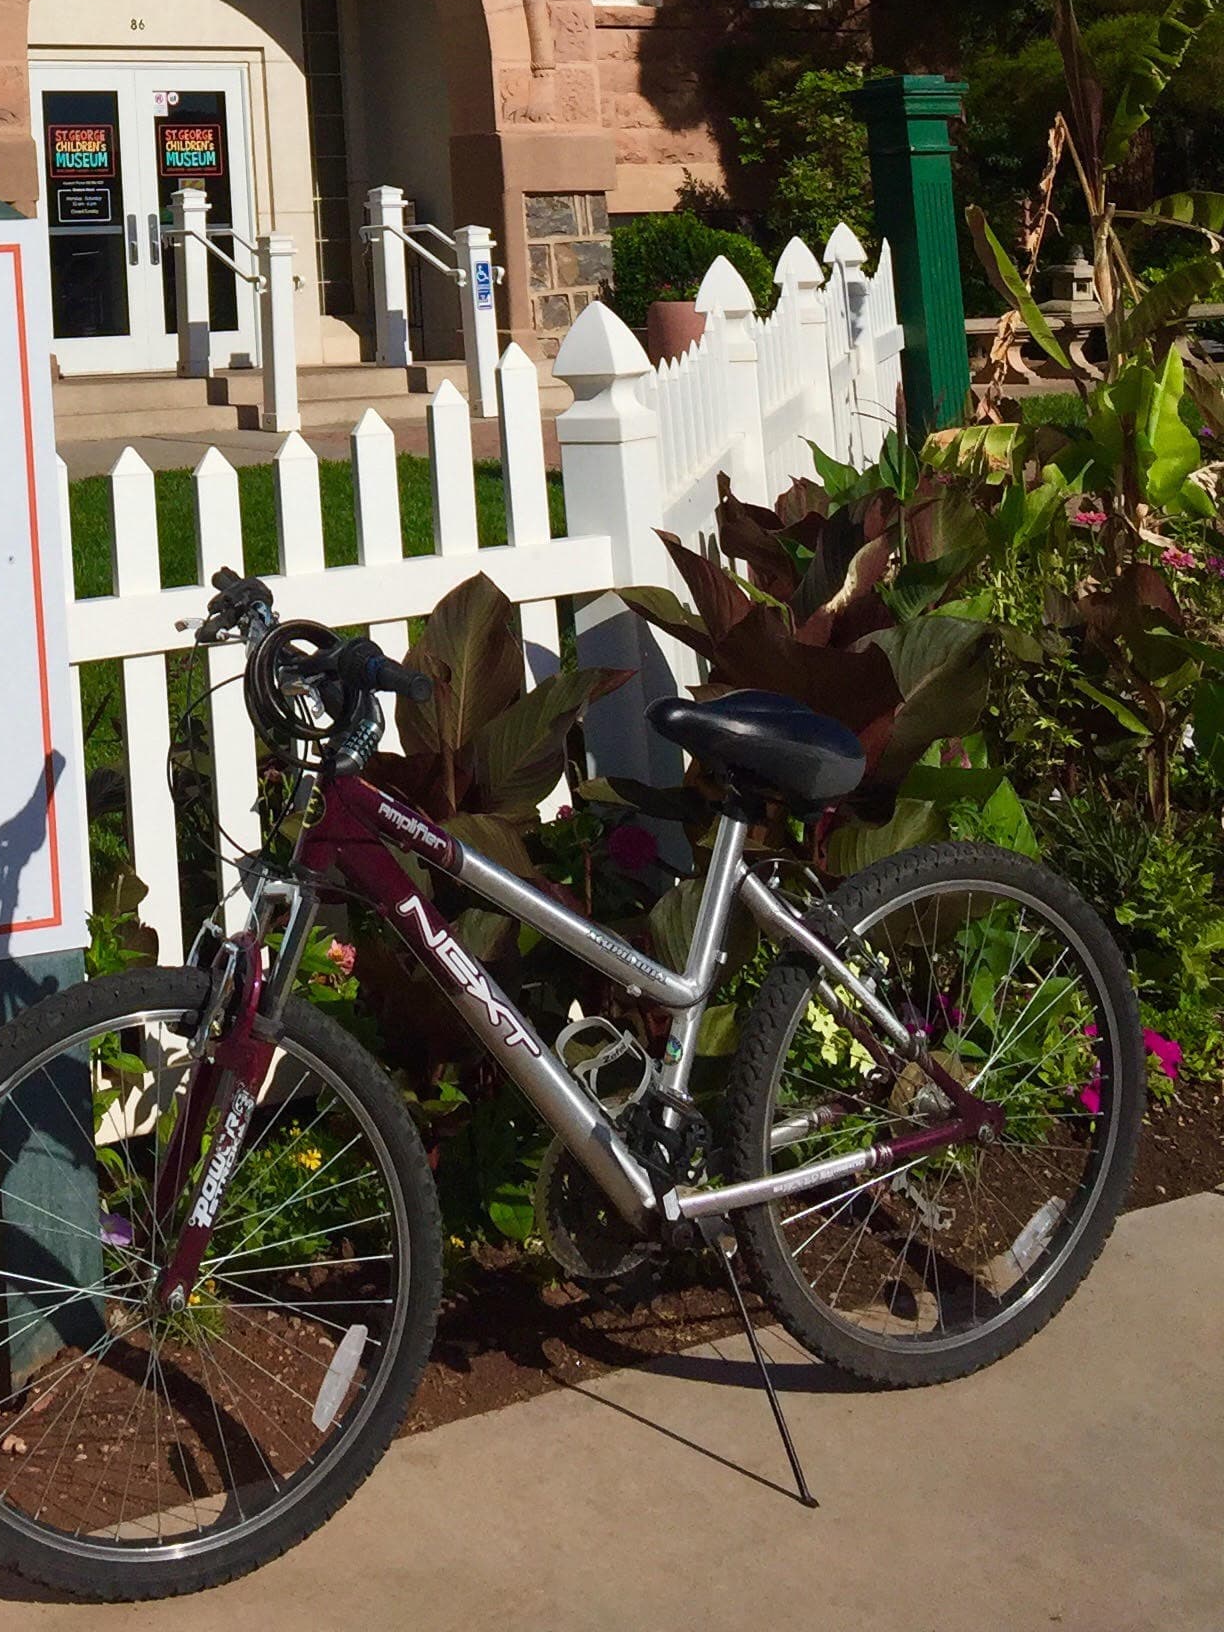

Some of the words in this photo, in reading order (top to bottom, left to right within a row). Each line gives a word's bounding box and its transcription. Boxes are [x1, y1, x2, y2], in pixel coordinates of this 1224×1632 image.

[130, 18, 146, 31] 86
[56, 152, 108, 168] MUSEUM
[166, 151, 216, 167] MUSEUM
[399, 894, 541, 1059] NEXT
